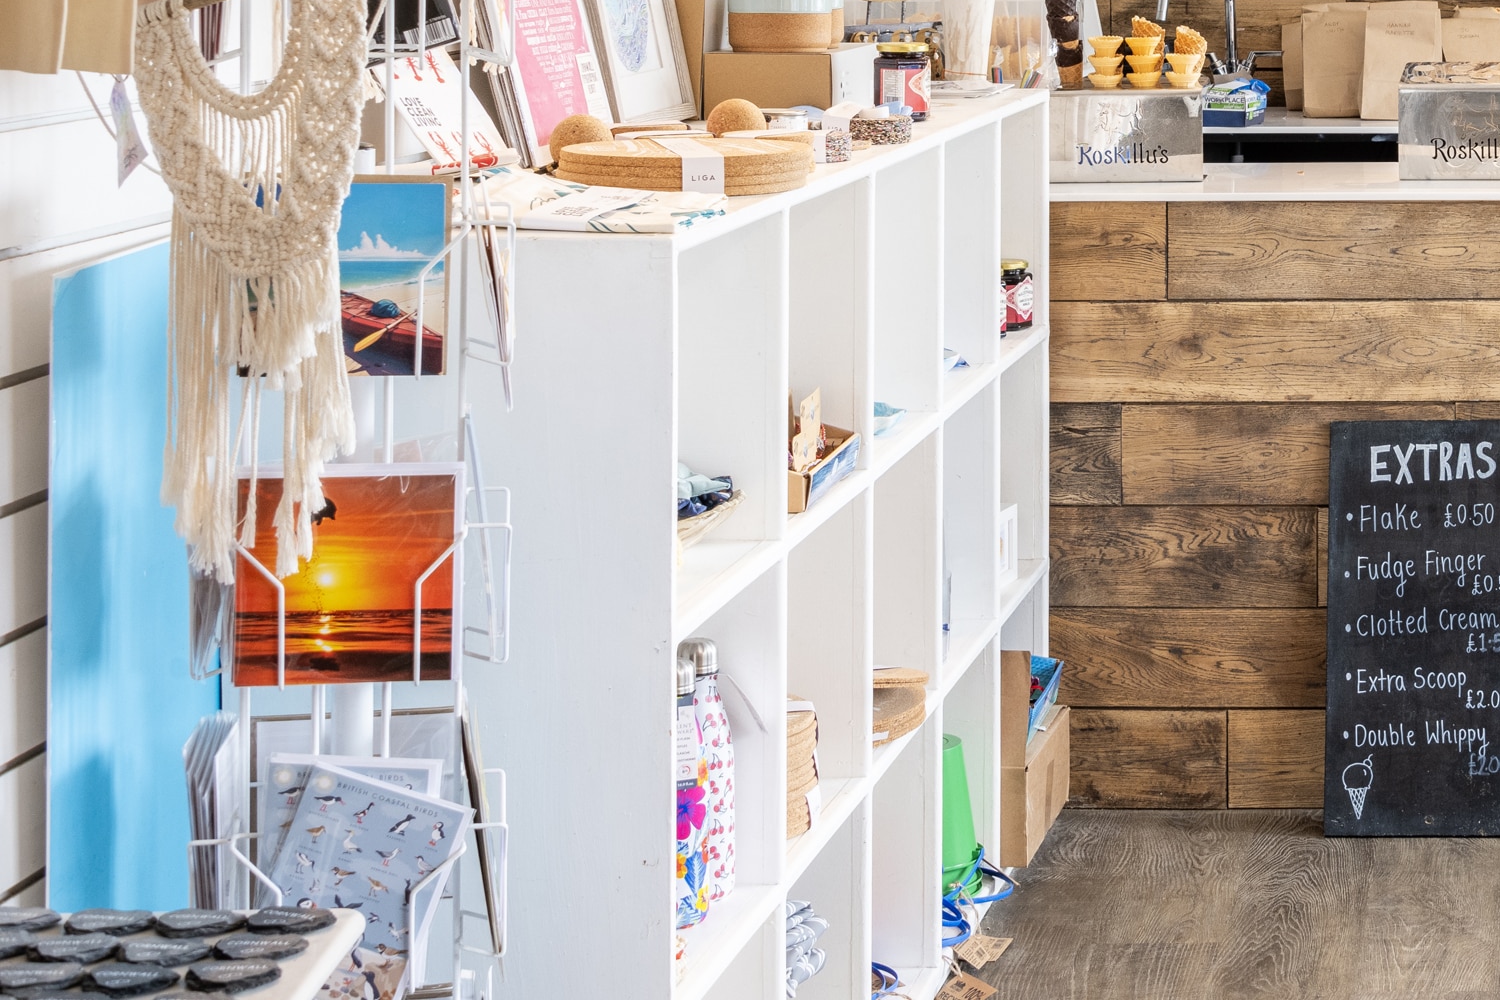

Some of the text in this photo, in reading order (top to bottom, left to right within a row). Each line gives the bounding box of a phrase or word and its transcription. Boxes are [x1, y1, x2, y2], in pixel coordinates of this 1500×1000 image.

[400, 97, 422, 107] LOVE
[407, 108, 434, 116] CLEAN
[414, 117, 442, 127] LIVING
[691, 174, 716, 182] LIGA
[1370, 441, 1497, 485] EXTRAS
[1360, 503, 1495, 532] Flake £0.50
[1357, 550, 1487, 597] Fudge Finger
[1356, 607, 1499, 636] Clotted Cream
[1356, 667, 1467, 698] Extra Scoop
[1355, 721, 1490, 757] Double Whippy
[379, 774, 404, 782] BIRDS
[336, 782, 439, 818] BRITISH COASTAL BIRDS
[129, 942, 189, 950] CORNWALL
